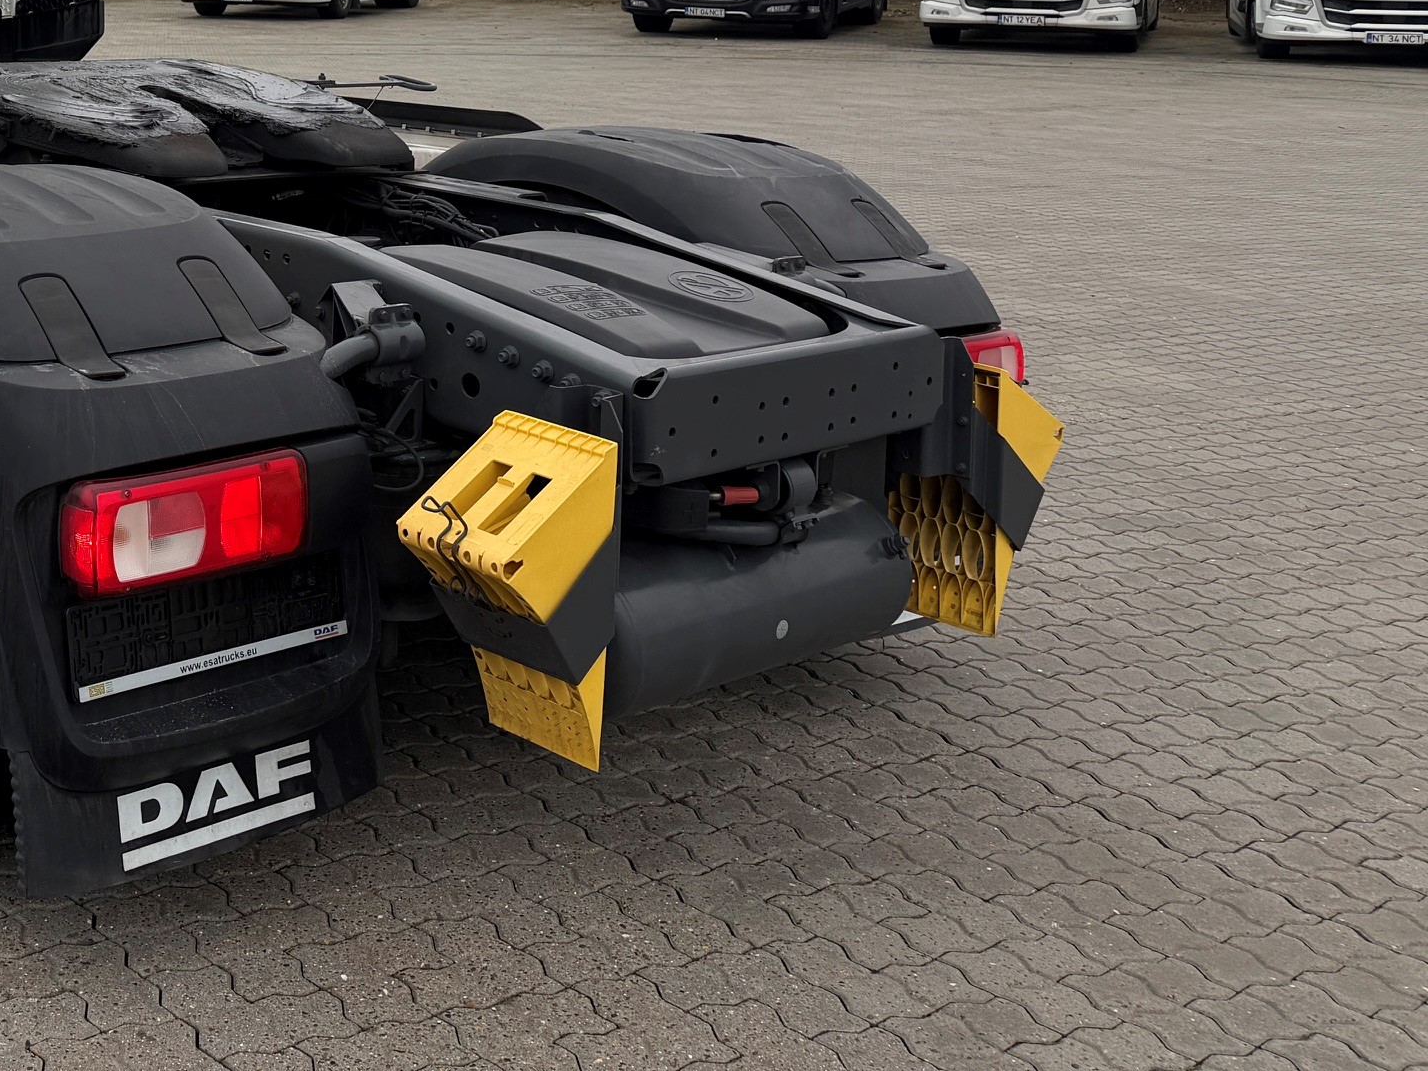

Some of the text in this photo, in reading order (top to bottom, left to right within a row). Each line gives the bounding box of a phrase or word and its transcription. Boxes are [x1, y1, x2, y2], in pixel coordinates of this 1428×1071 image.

[1003, 15, 1043, 24] NT 12 YEA
[1372, 34, 1422, 43] NT 34 NCT
[179, 624, 339, 674] www.esatrucks.eu DAF
[117, 739, 312, 844] DAF
